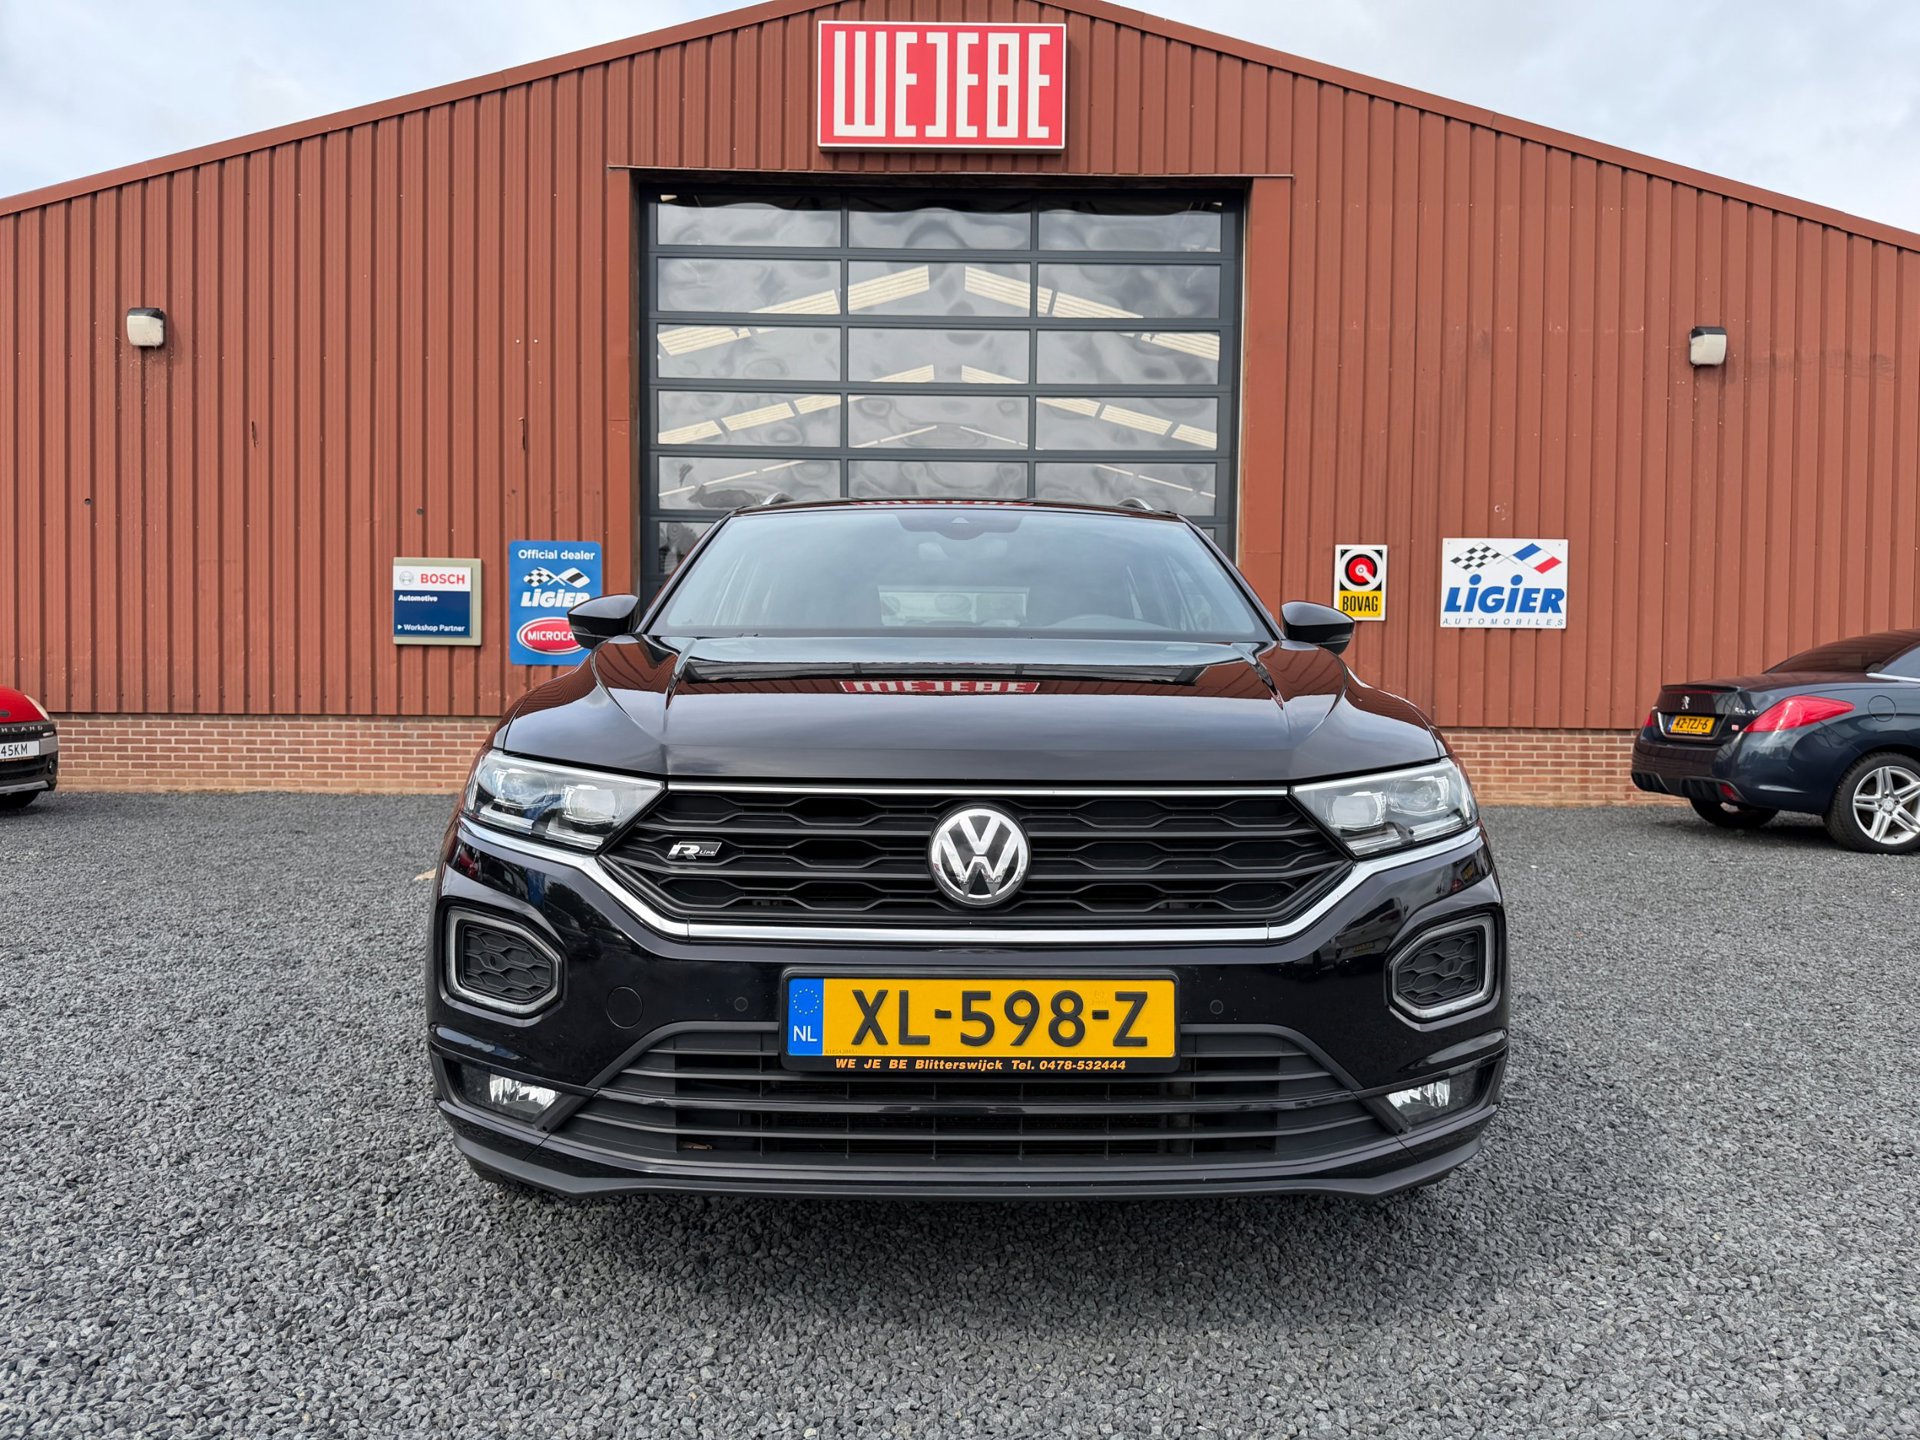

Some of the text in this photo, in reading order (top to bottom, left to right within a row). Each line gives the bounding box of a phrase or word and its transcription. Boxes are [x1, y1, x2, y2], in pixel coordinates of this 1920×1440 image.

[833, 30, 1051, 139] WEJEBE
[518, 549, 596, 560] Official dealer
[420, 573, 465, 585] BOSCH
[398, 594, 438, 602] Automotive
[1342, 595, 1379, 612] BOVAG
[403, 624, 465, 632] Workshop Partner
[1442, 618, 1564, 626] AUTOMOBILES
[851, 989, 1148, 1047] XL-598-Z
[793, 1025, 818, 1042] NL
[836, 1058, 1126, 1072] WE JE BE Blitterswijck Tel. 0478-532444
